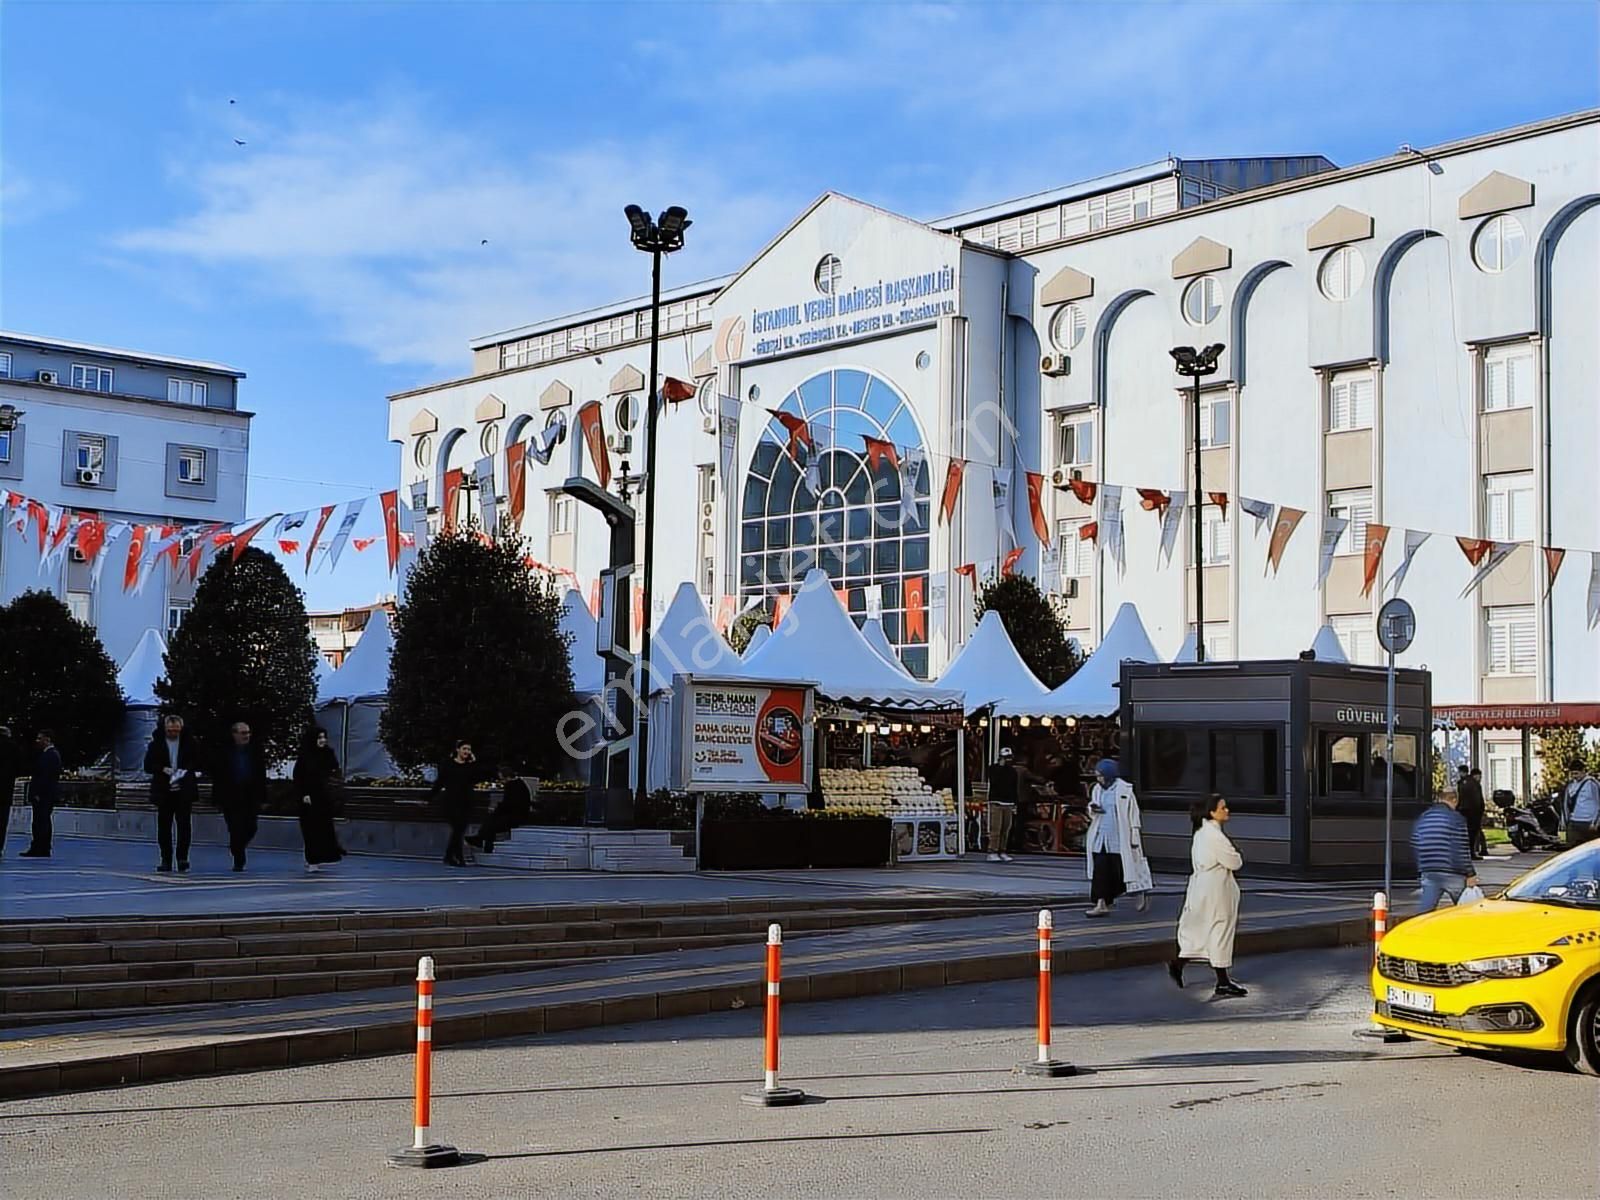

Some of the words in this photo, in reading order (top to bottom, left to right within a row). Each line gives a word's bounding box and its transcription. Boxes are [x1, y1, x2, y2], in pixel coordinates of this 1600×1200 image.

[752, 308, 802, 334] İSTANBUL
[803, 291, 836, 323] VERGİ
[838, 279, 882, 315] DAİRESİ
[885, 264, 955, 307] BAŞKANLIĞI
[727, 694, 756, 705] HAKAN
[1336, 707, 1400, 726] GÜVENLK
[695, 724, 719, 734] DAHA
